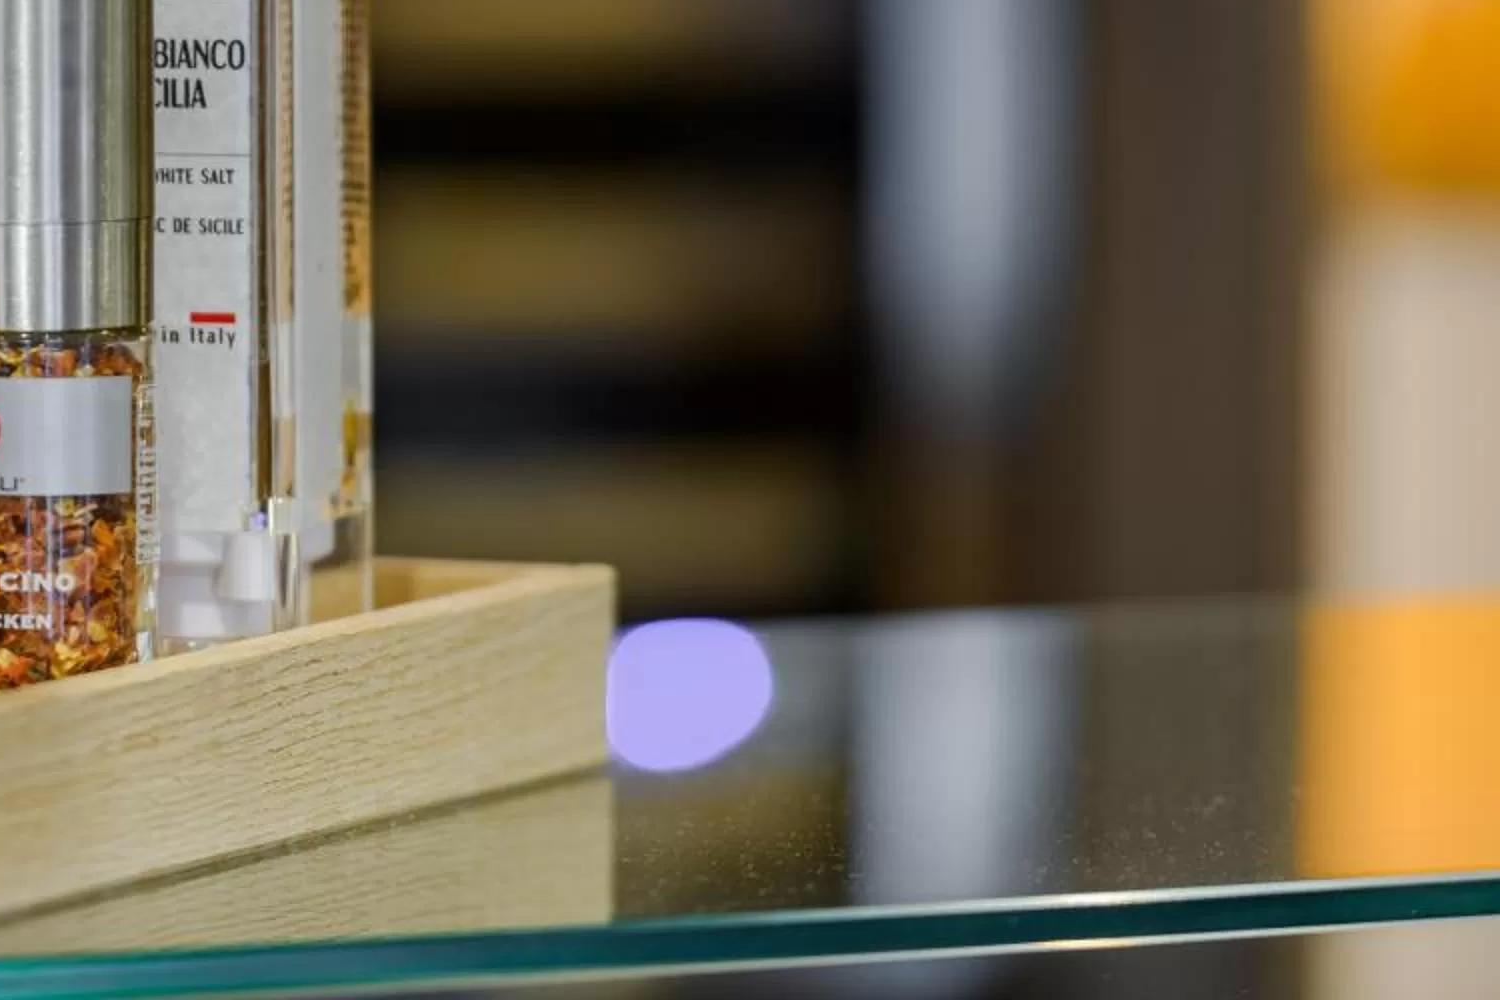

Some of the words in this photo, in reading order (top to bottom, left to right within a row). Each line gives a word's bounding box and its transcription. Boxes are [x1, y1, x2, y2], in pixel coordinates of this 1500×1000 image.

[154, 37, 246, 71] BIANCO
[199, 167, 236, 185] SALT
[172, 216, 192, 234] DE
[198, 217, 245, 236] SICILE
[160, 326, 180, 344] in
[189, 327, 237, 349] Italy
